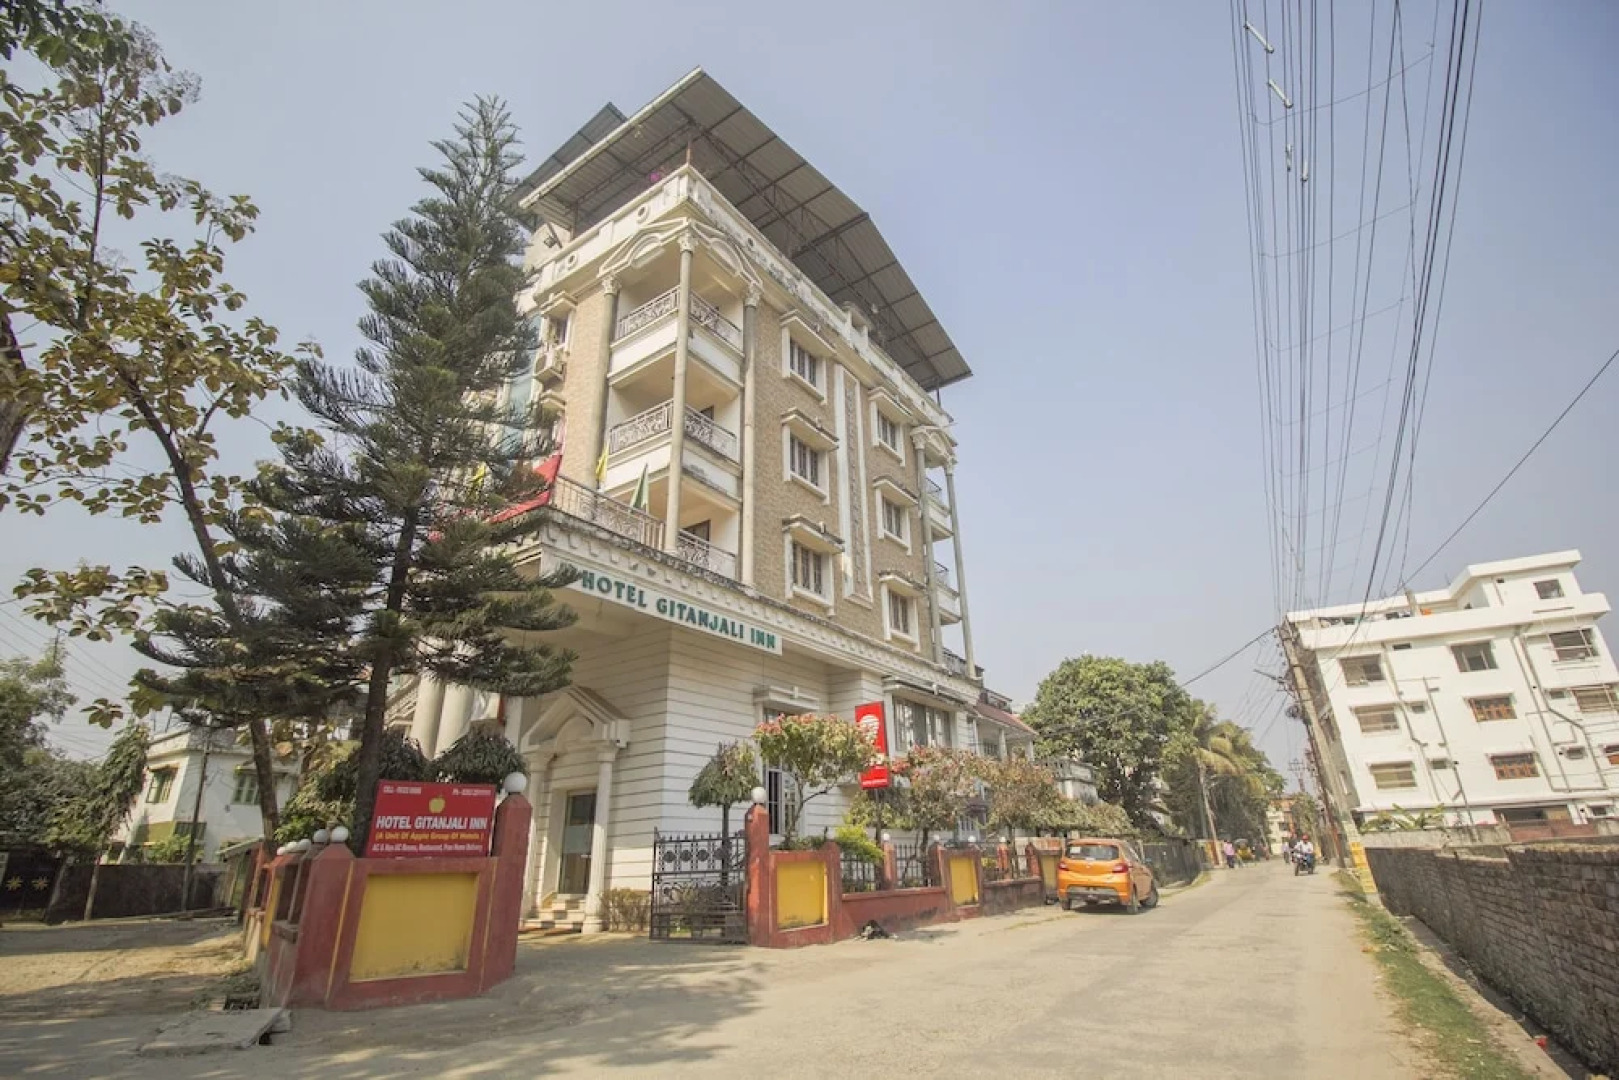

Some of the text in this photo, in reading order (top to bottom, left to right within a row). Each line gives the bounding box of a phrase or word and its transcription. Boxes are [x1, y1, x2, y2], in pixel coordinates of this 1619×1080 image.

[582, 569, 776, 649] HOTEL GITANJALI INN
[375, 815, 488, 830] HOTEL GITANJALI INN
